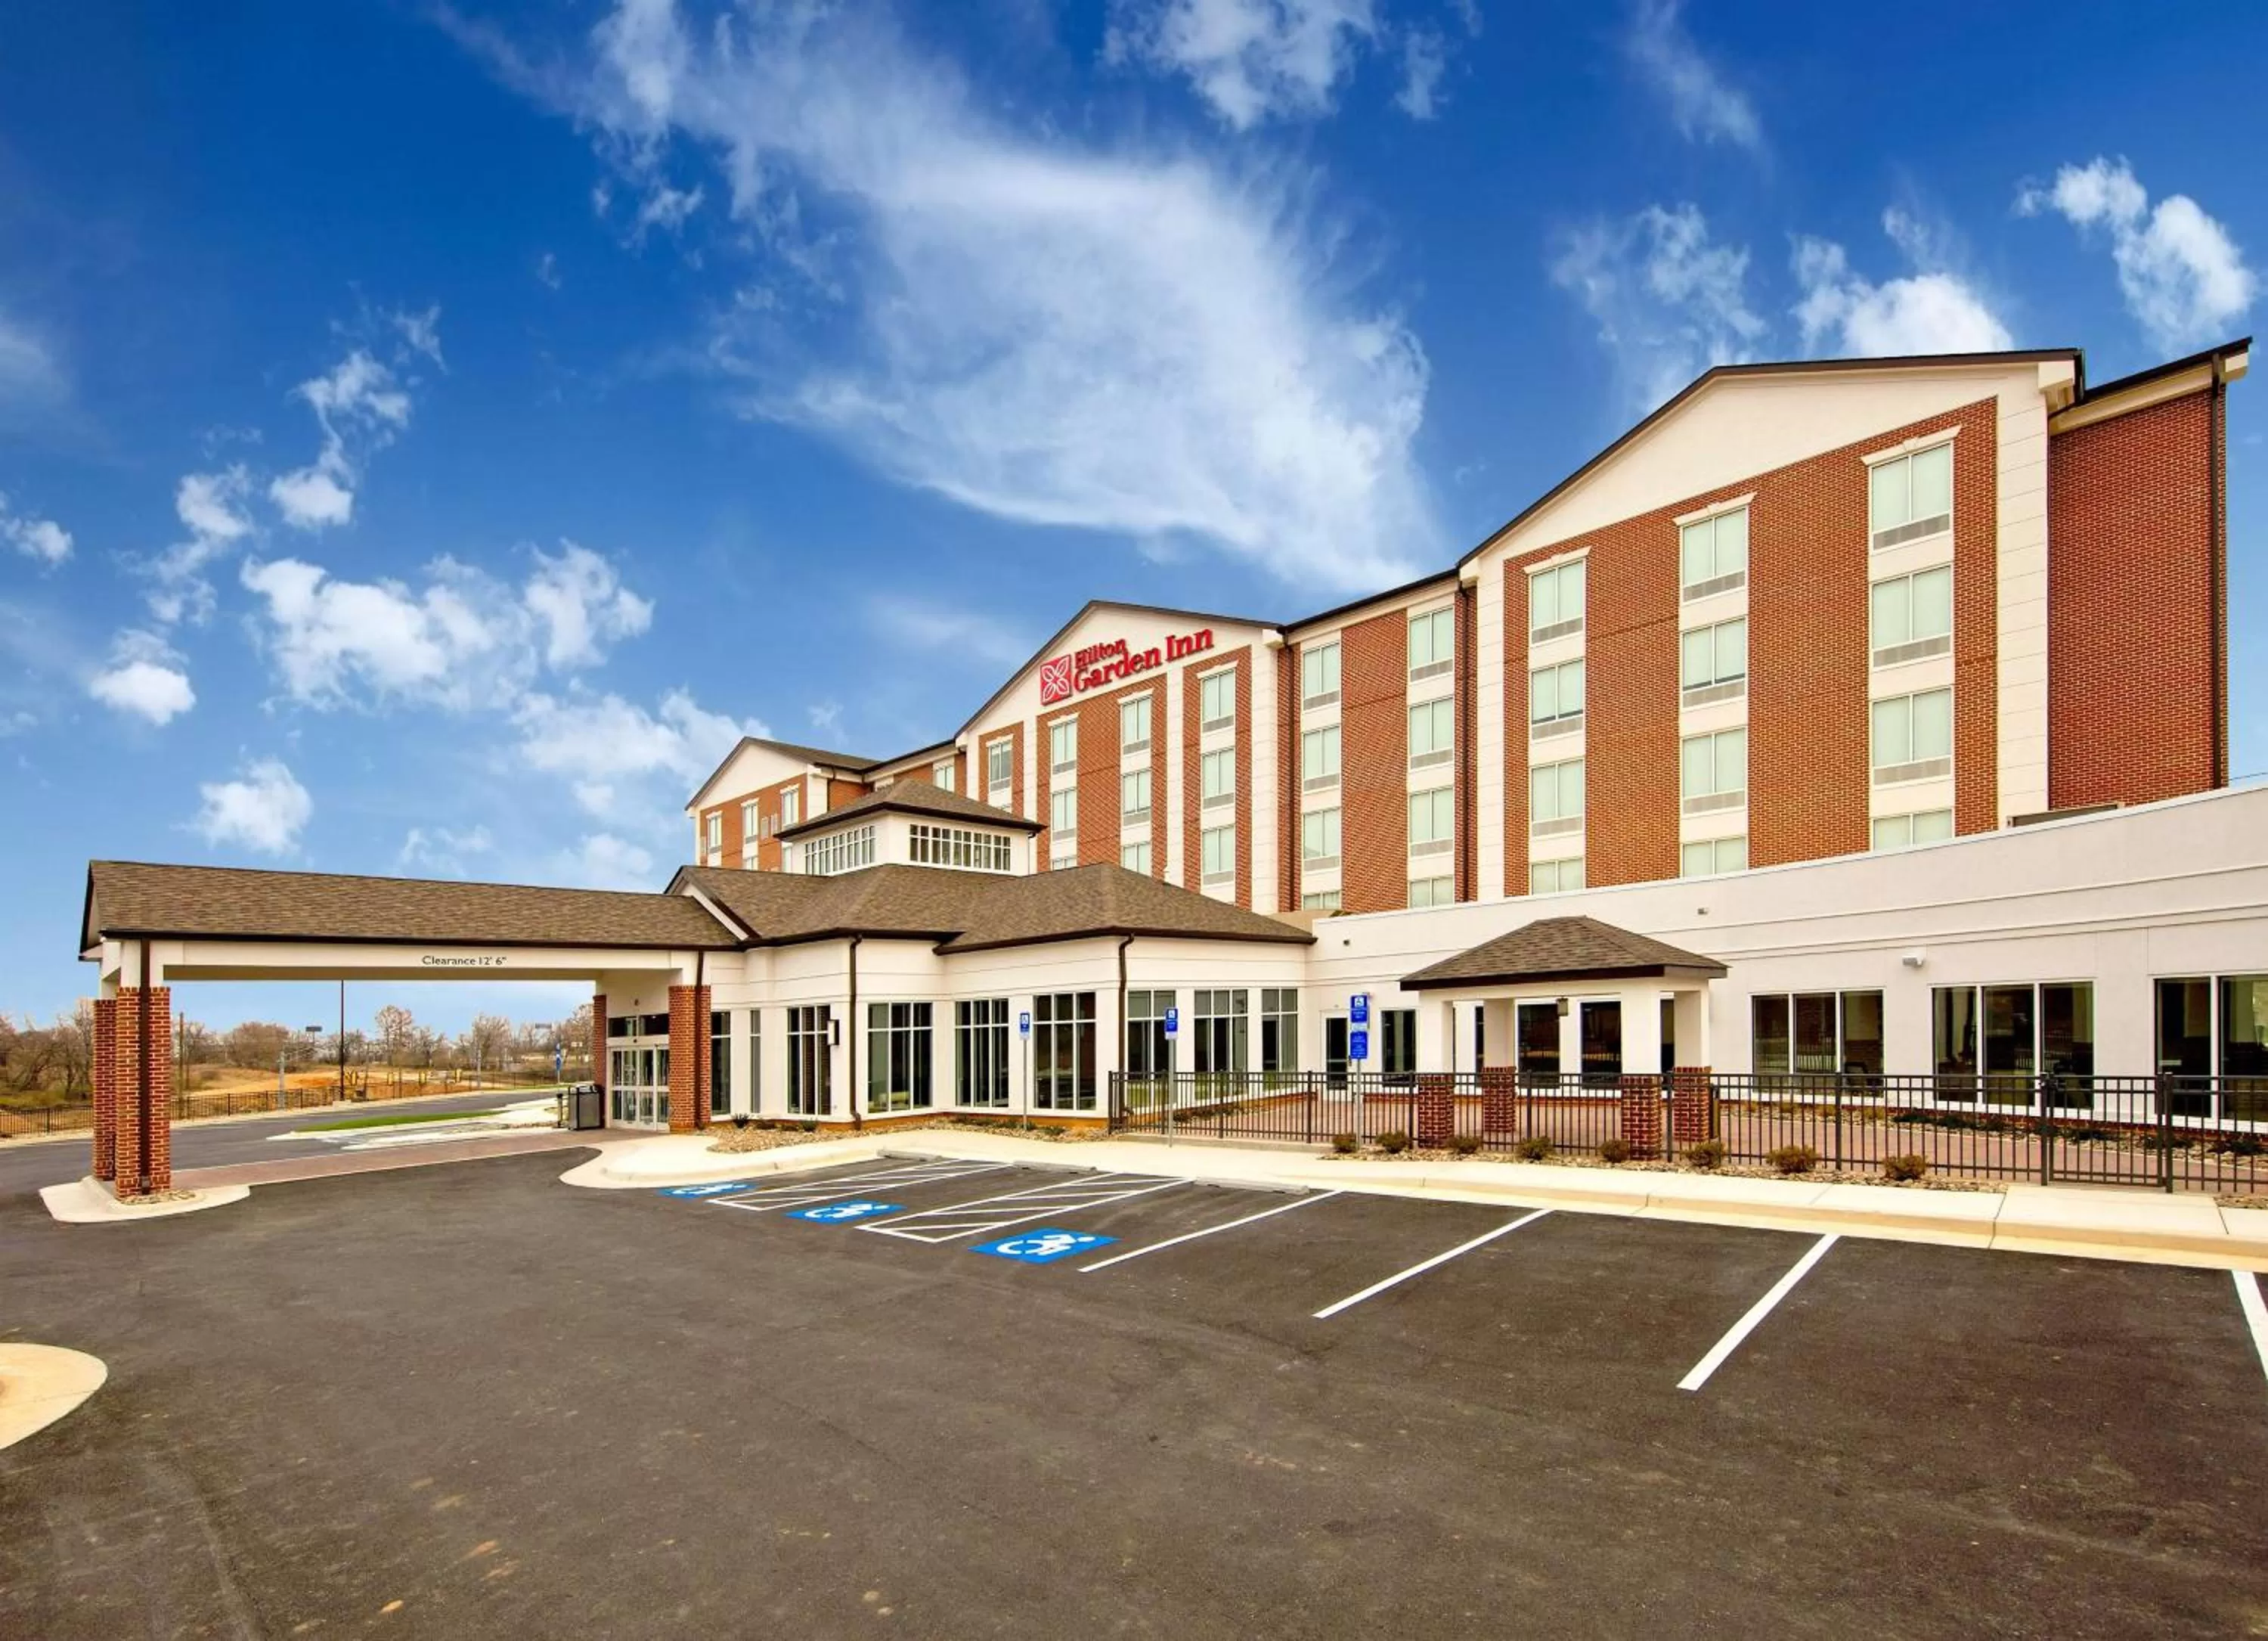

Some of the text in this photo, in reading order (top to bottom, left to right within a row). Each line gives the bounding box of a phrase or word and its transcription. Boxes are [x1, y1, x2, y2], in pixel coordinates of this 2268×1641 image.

[1074, 639, 1126, 669] Hilton
[1074, 628, 1214, 692] Garden Inn
[422, 955, 476, 966] Clearance
